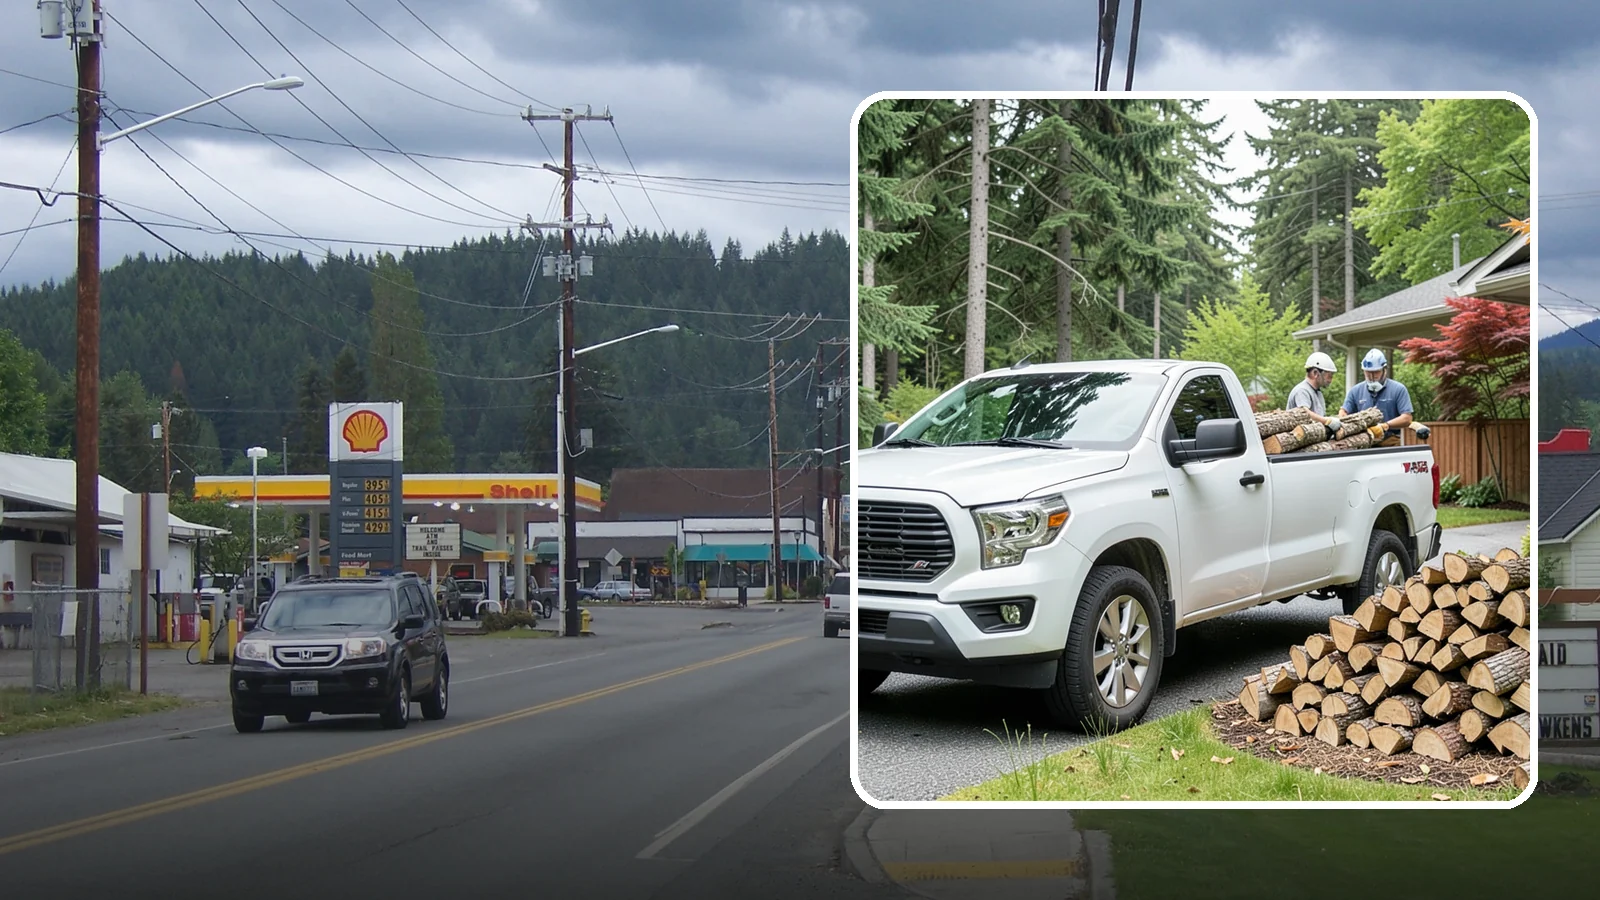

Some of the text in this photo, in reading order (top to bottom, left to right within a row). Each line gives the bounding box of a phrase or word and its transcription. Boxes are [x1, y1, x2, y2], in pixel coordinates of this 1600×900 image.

[366, 480, 384, 490] 395
[490, 484, 547, 499] Shell
[366, 494, 384, 504] 405
[366, 508, 384, 518] 415
[366, 522, 384, 532] 429
[1538, 643, 1567, 665] AID
